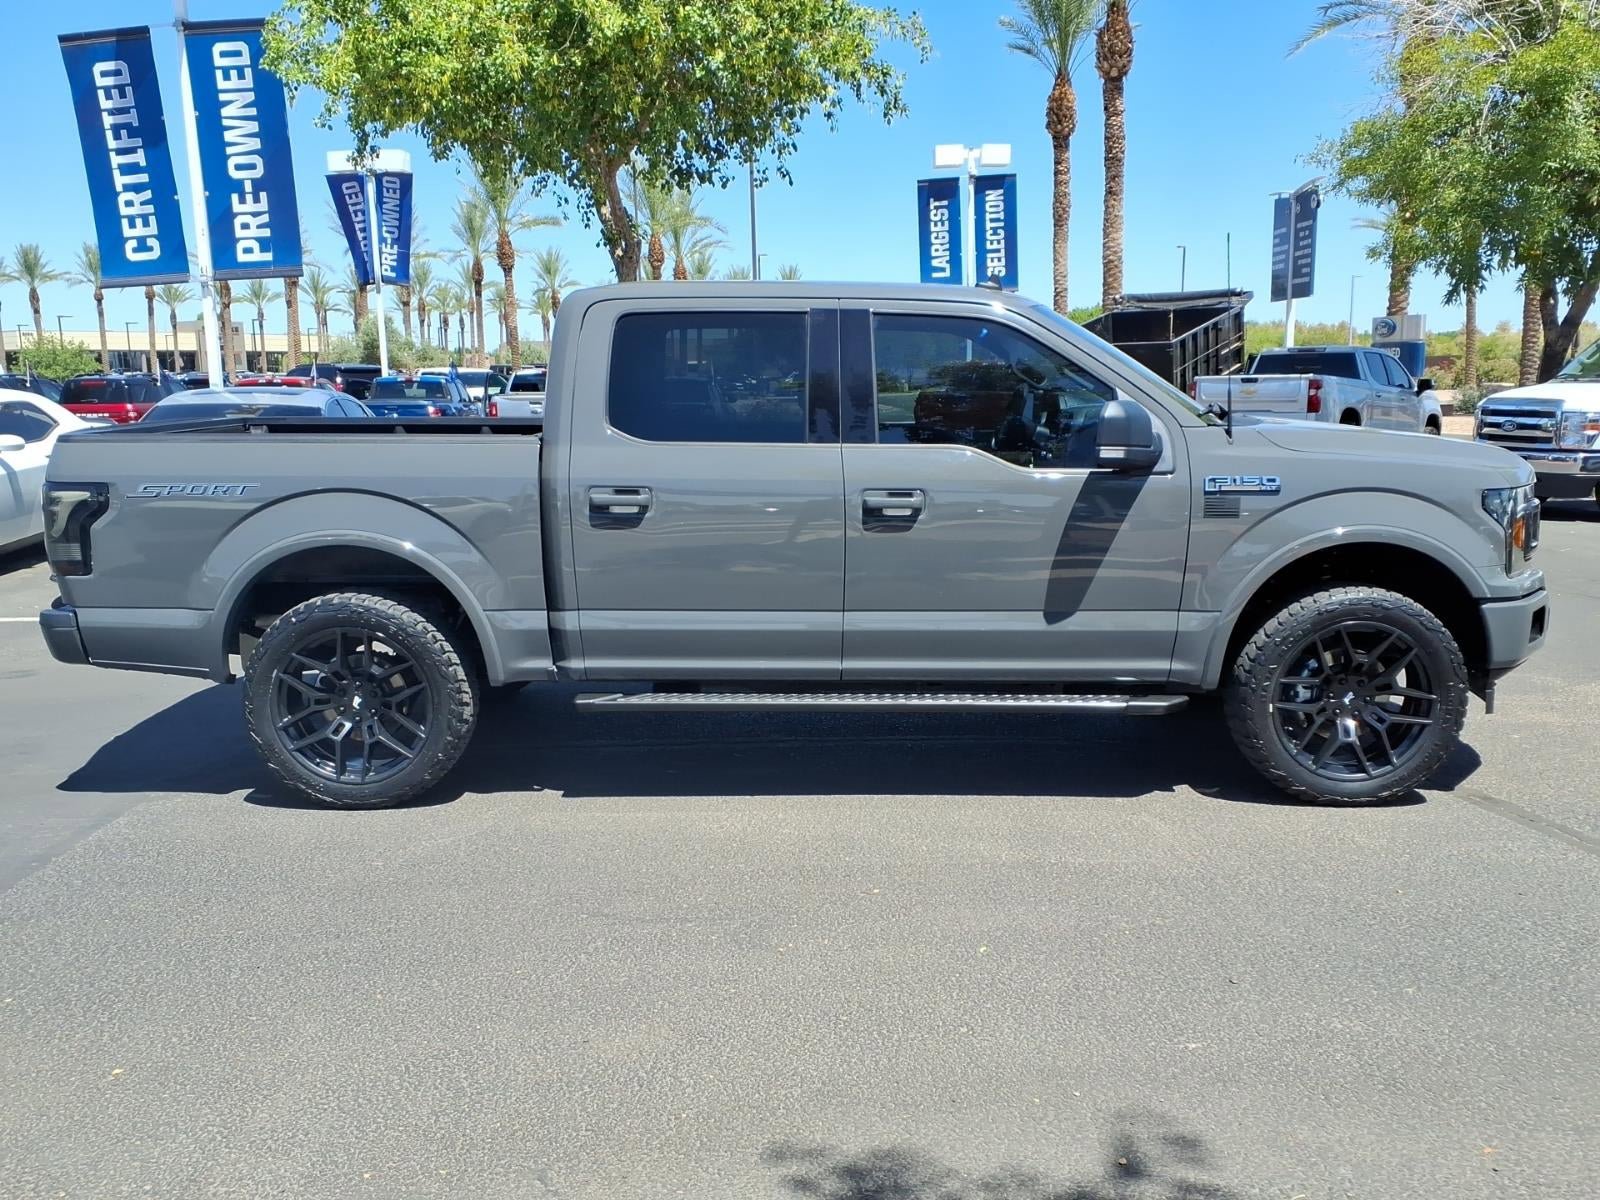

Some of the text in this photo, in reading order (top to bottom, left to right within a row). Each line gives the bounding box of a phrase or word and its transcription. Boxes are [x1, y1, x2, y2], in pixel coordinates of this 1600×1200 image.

[92, 60, 161, 262] CERTIFIED
[212, 40, 273, 263] PRE-OWNED
[341, 181, 369, 268] RTIFIED
[382, 176, 400, 277] PRE-OWNED
[930, 198, 950, 278] LARGEST
[985, 189, 1006, 277] SELECTION
[125, 482, 260, 499] SPORT
